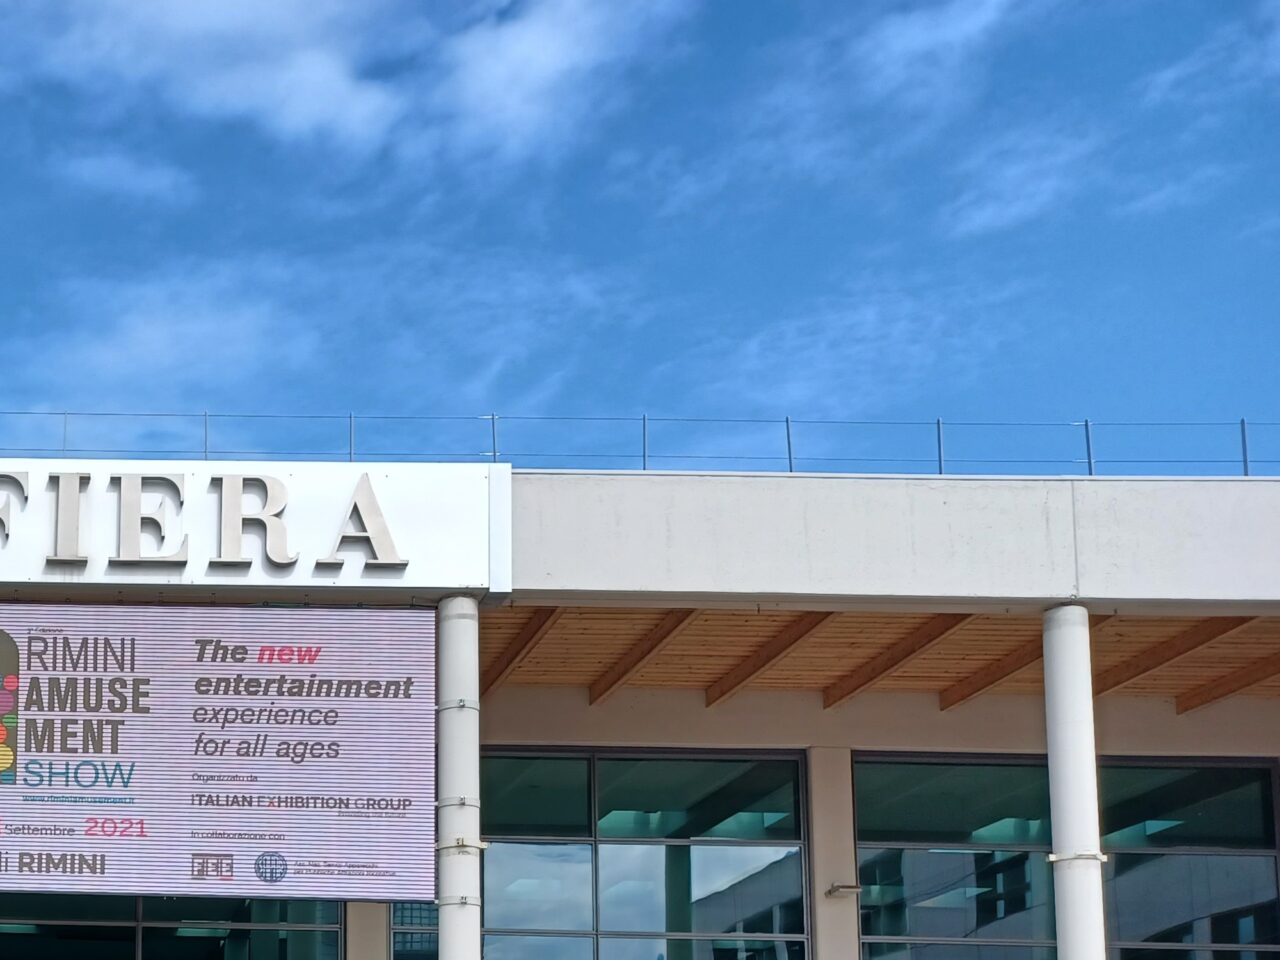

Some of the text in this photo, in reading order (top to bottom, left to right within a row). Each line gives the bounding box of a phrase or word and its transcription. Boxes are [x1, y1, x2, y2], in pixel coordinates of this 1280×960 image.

[26, 636, 135, 672] RIMINI
[195, 639, 322, 664] The new
[24, 677, 151, 713] AMUSE
[194, 674, 415, 699] entertainment
[192, 702, 340, 730] experience
[24, 719, 125, 754] MENT
[194, 732, 342, 764] for all ages
[23, 759, 136, 788] SHOW
[191, 794, 412, 811] ITALIAN EXHIBITION GROUP
[4, 824, 76, 837] Settembre
[84, 817, 148, 838] 2021
[18, 853, 106, 875] RIMINI
